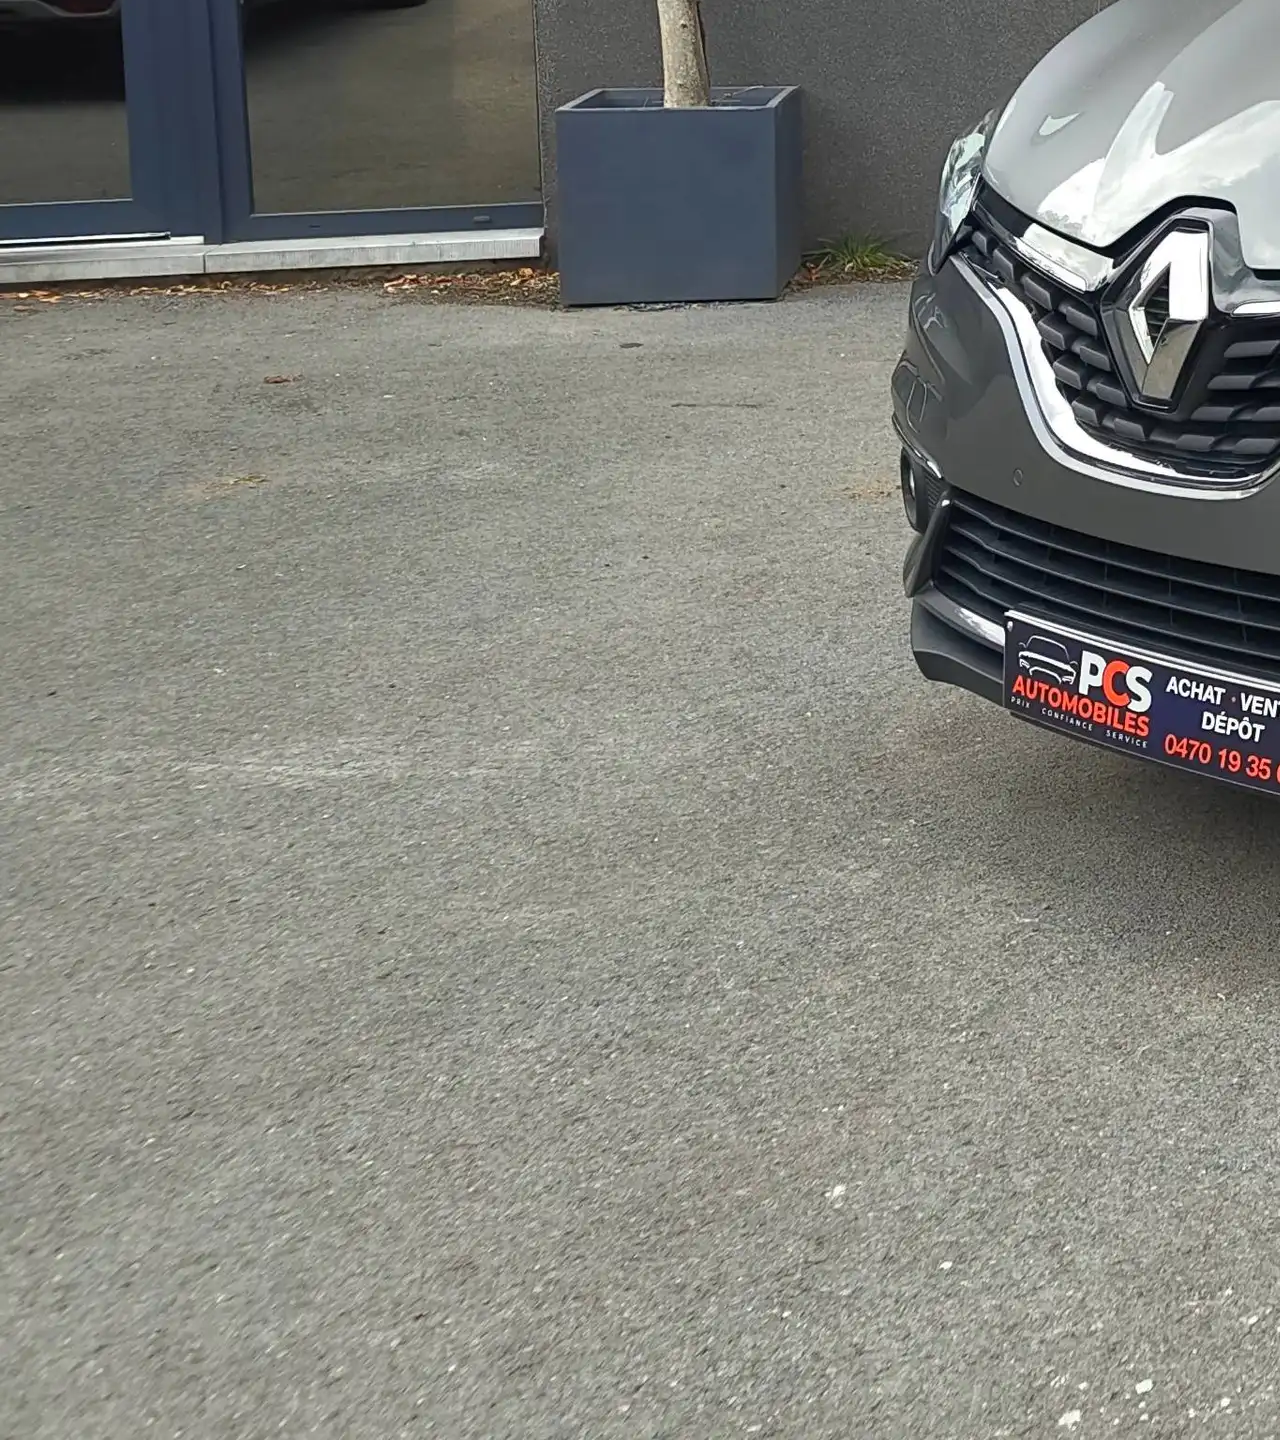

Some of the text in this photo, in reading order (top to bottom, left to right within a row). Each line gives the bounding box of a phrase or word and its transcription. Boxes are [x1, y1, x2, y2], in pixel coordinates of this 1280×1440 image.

[1078, 649, 1154, 713] PCS
[1165, 675, 1226, 706] ACHAT
[1010, 696, 1149, 749] PRIX CONFIANCE SERVICE
[1011, 674, 1150, 738] AUTOMOBILES
[1201, 710, 1266, 743] DÉPÔT
[1164, 734, 1213, 765] 0470
[1218, 748, 1242, 773] 19
[1245, 755, 1272, 780] 35
